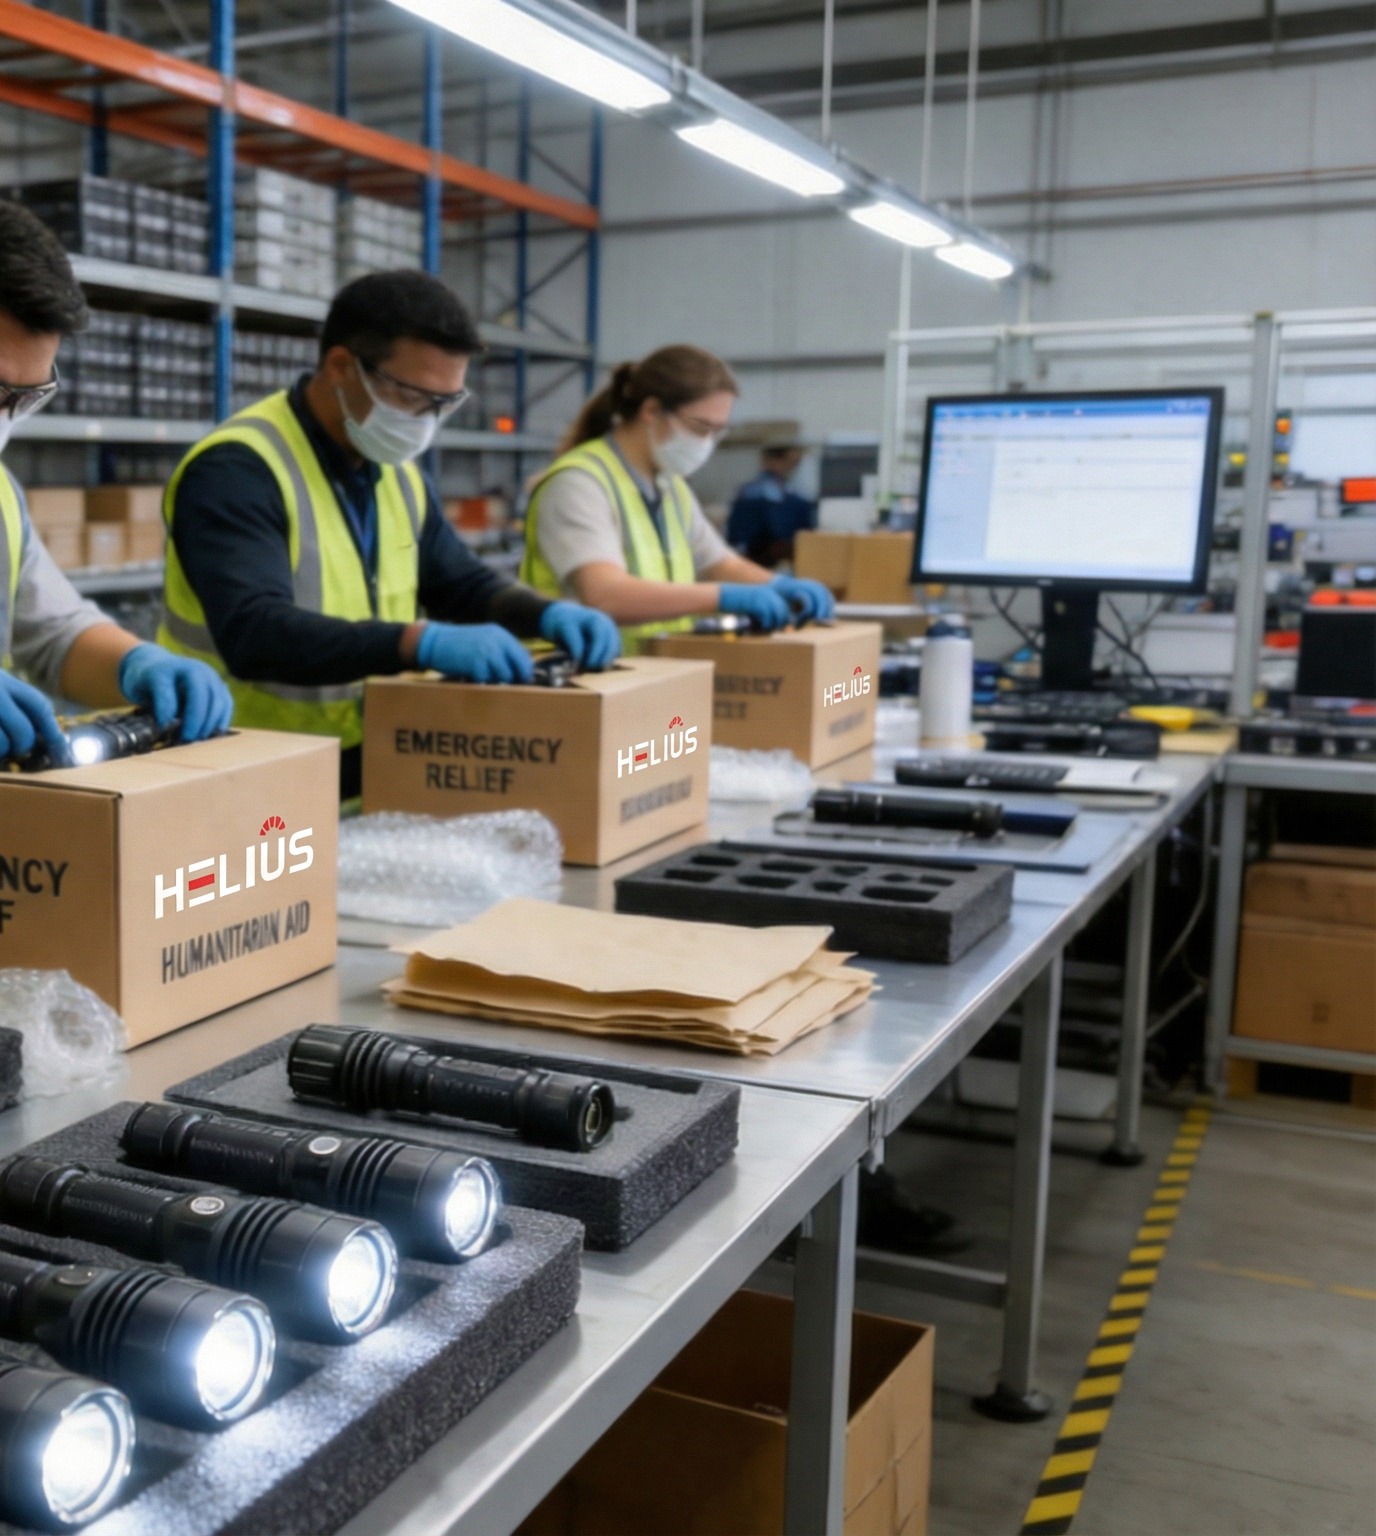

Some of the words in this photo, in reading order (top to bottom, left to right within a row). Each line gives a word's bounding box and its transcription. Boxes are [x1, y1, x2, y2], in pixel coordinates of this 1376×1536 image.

[823, 674, 871, 708] HELIUS
[394, 728, 562, 764] EMERGENCY
[617, 725, 698, 779] HELIUS
[425, 762, 516, 795] RELIEF
[154, 827, 314, 920] HELIUS
[284, 900, 310, 940] AID
